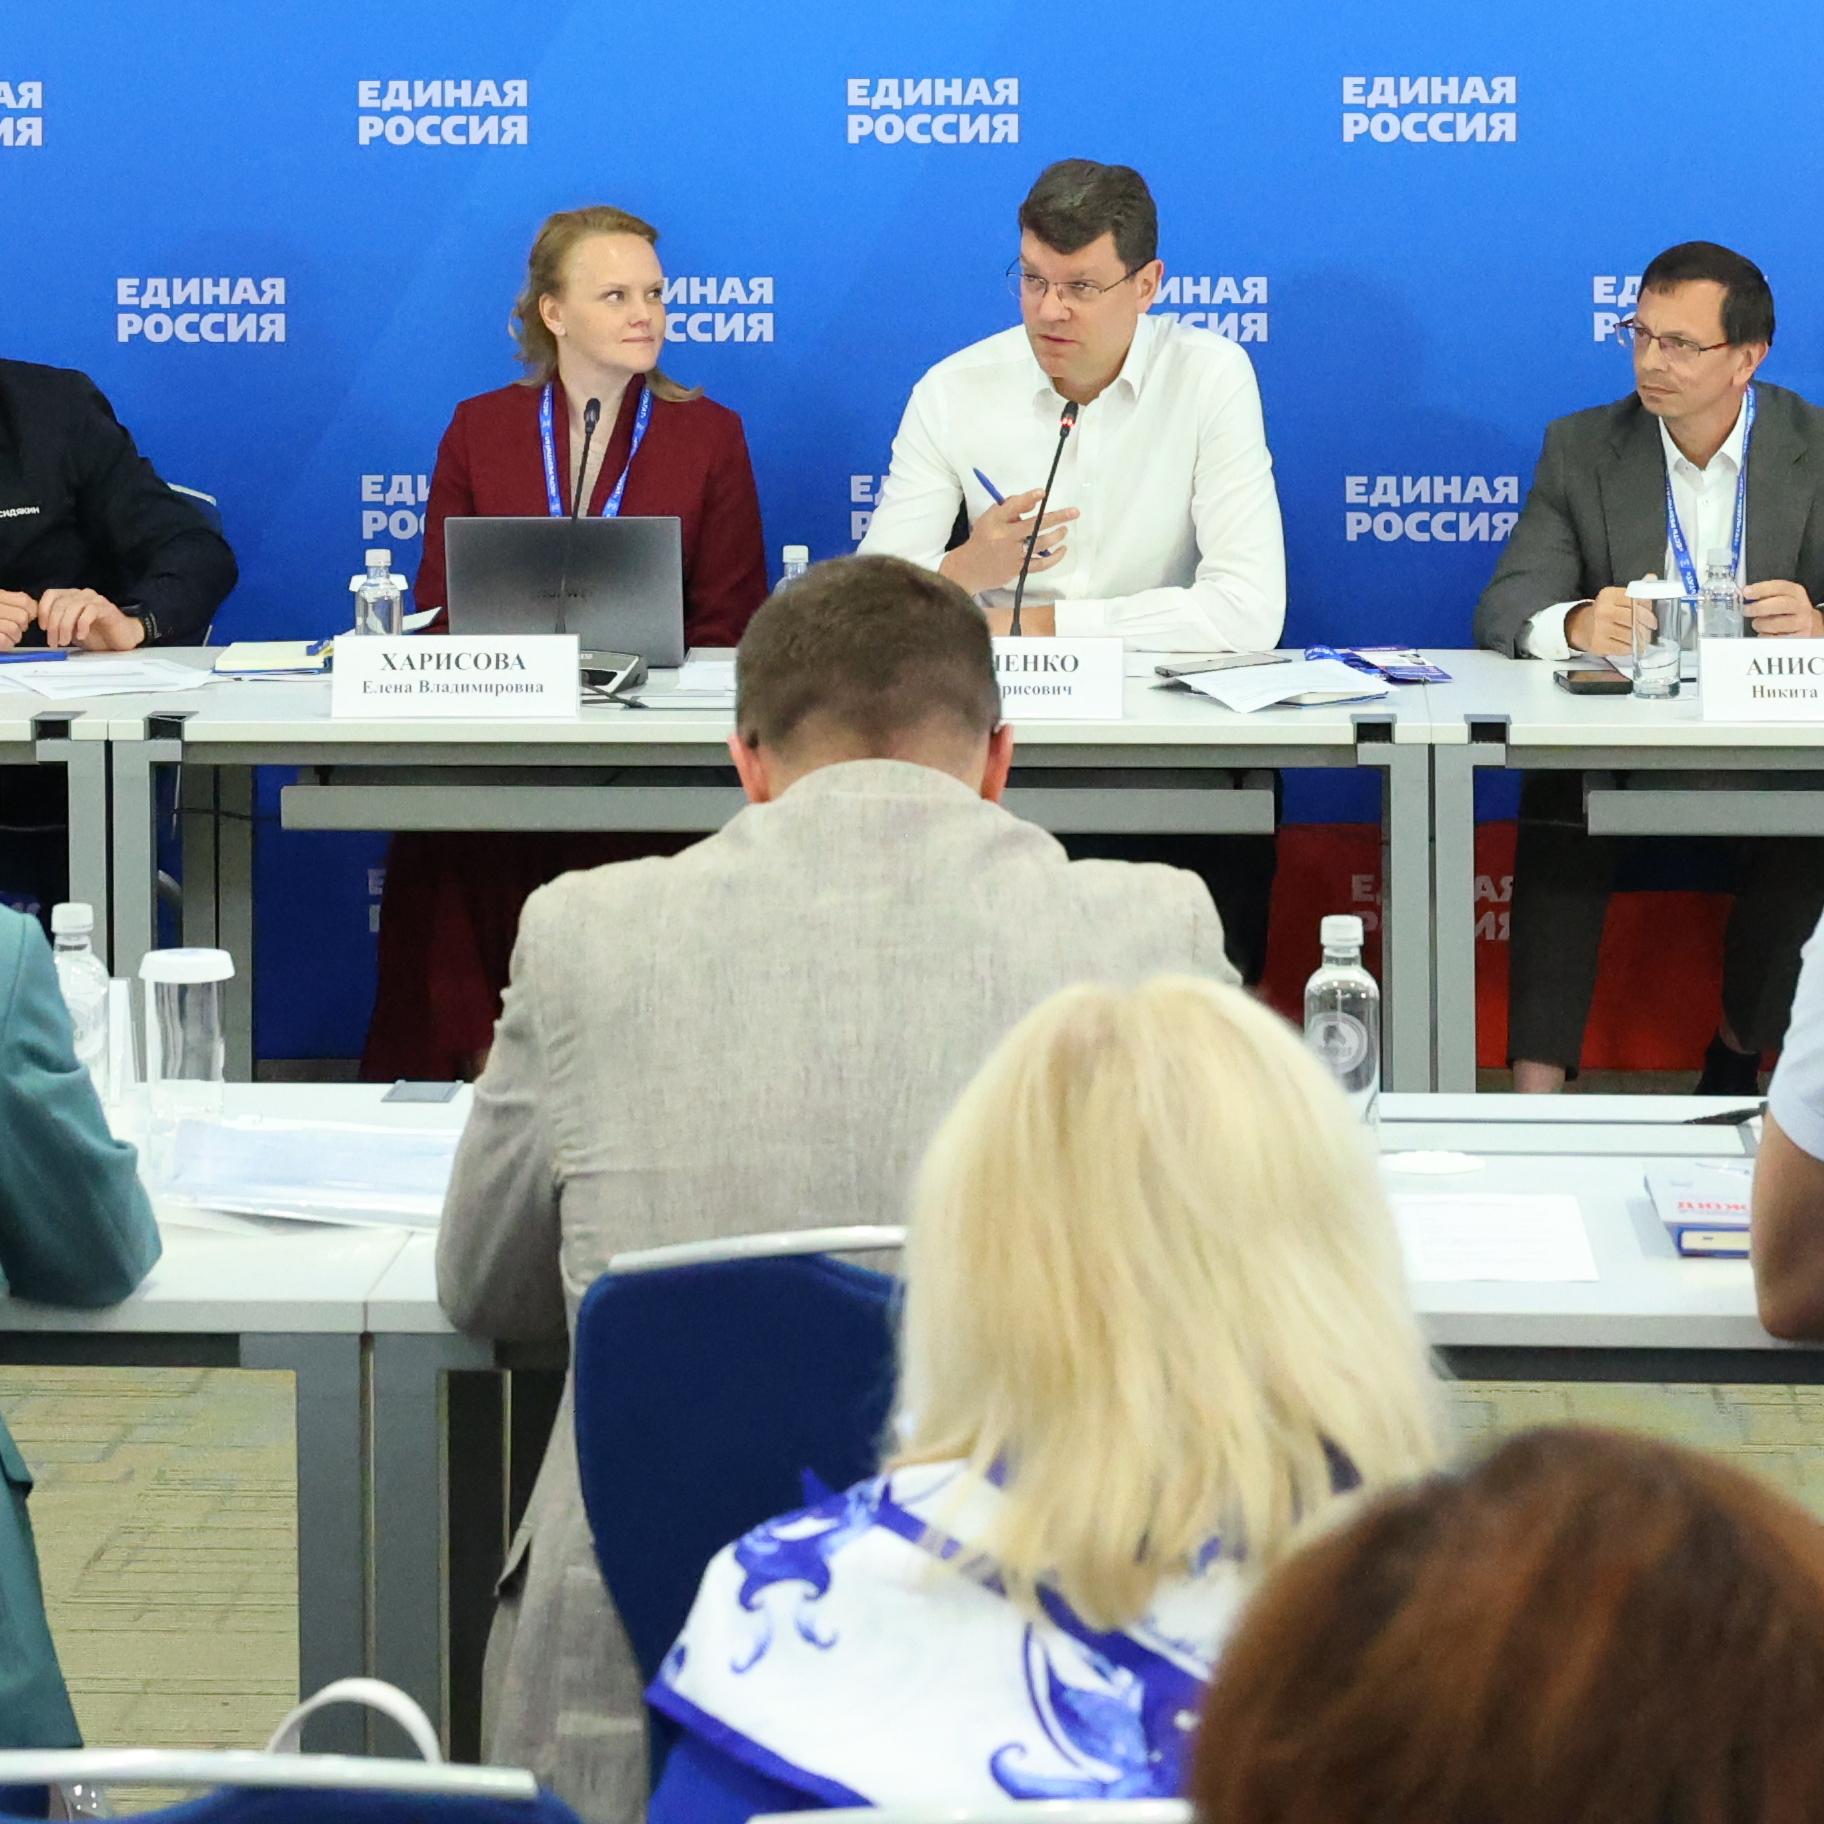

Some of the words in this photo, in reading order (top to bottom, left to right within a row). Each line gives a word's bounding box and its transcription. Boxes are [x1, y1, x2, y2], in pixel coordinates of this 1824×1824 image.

[359, 80, 527, 111] ЕДИНАЯ
[848, 78, 1018, 109] ЕДИНАЯ
[1343, 77, 1516, 108] ЕДИНАЯ
[359, 116, 527, 145] РОССИЯ
[848, 114, 1018, 143] РОССИЯ
[1343, 113, 1516, 142] РОССИЯ
[118, 278, 284, 308] ЕДИНАЯ
[660, 277, 774, 304] ИНАЯ
[1153, 277, 1268, 304] ИНАЯ
[118, 314, 285, 342] РОССИЯ
[666, 313, 774, 342] ССИЯ
[1346, 476, 1519, 507] ЕДИНАЯ
[382, 653, 525, 670] ХАРИСОВА
[363, 681, 412, 693] Елена
[420, 680, 543, 696] Владимировна
[1002, 685, 1072, 699] рисович
[1753, 685, 1817, 698] Никита
